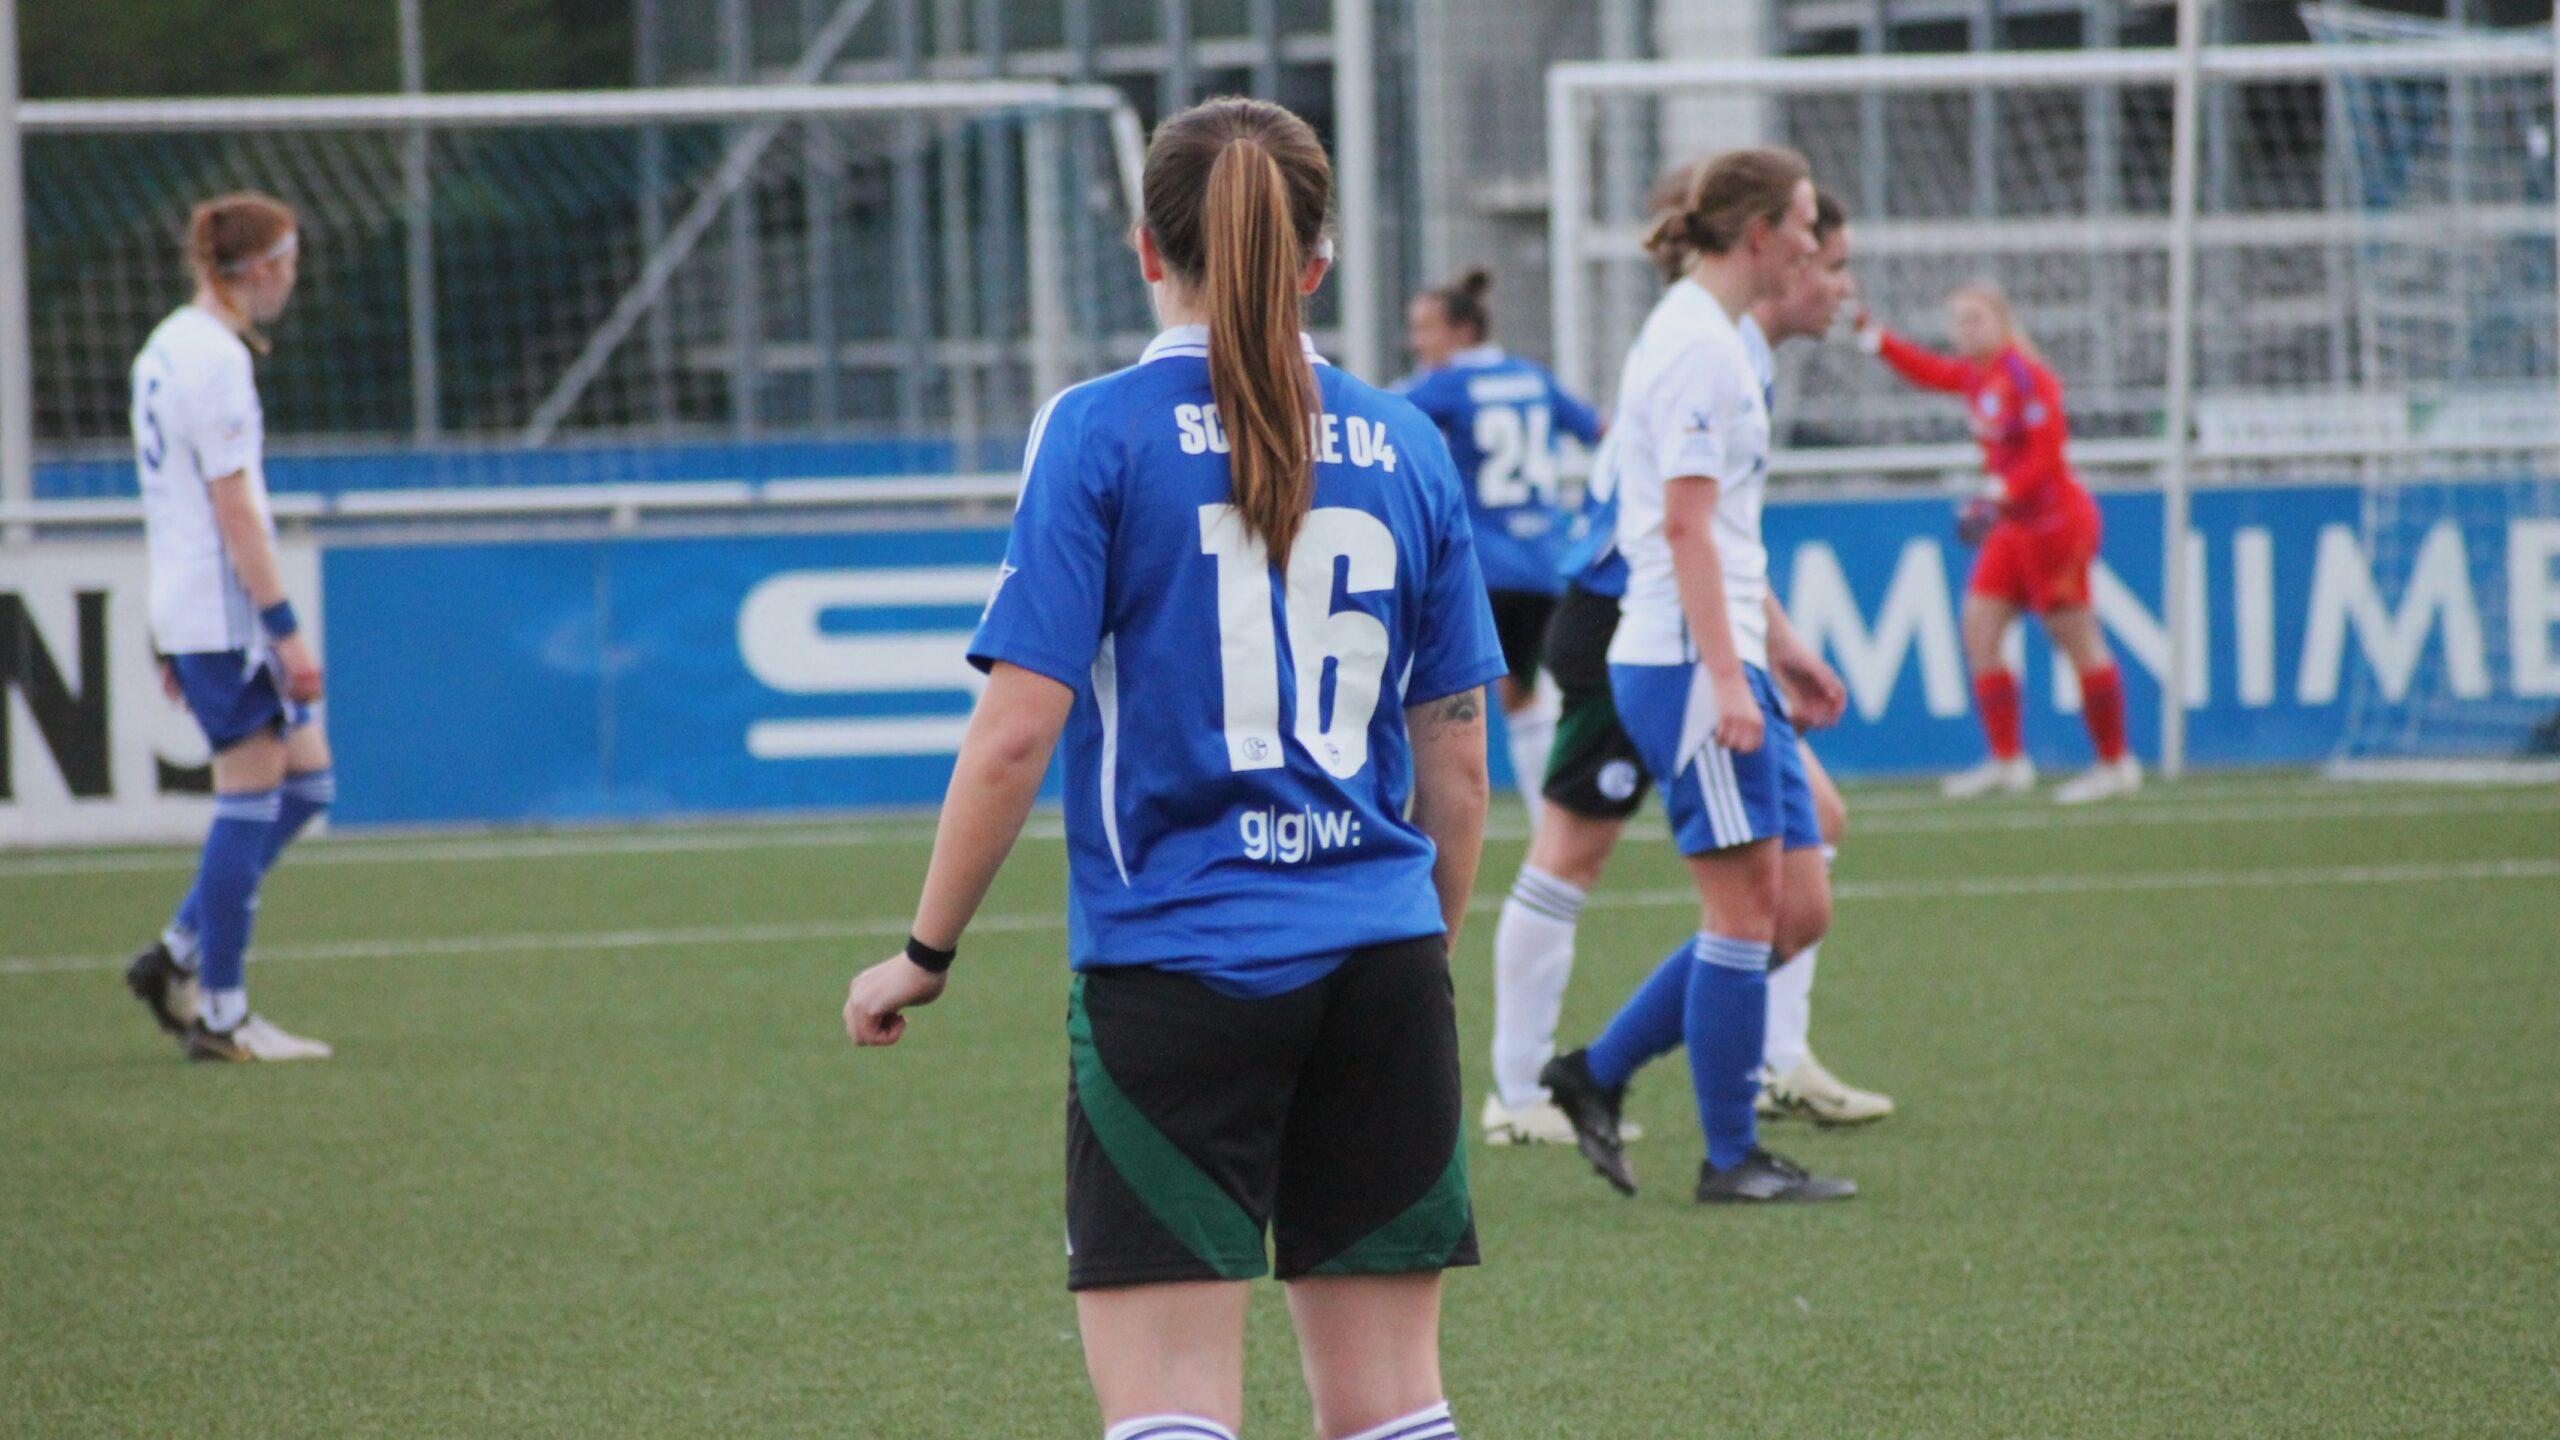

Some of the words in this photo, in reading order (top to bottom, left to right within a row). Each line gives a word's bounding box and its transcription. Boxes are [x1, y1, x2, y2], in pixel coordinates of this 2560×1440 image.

[1345, 416, 1397, 473] 04
[1473, 404, 1557, 509] 24
[1198, 503, 1397, 780] 16
